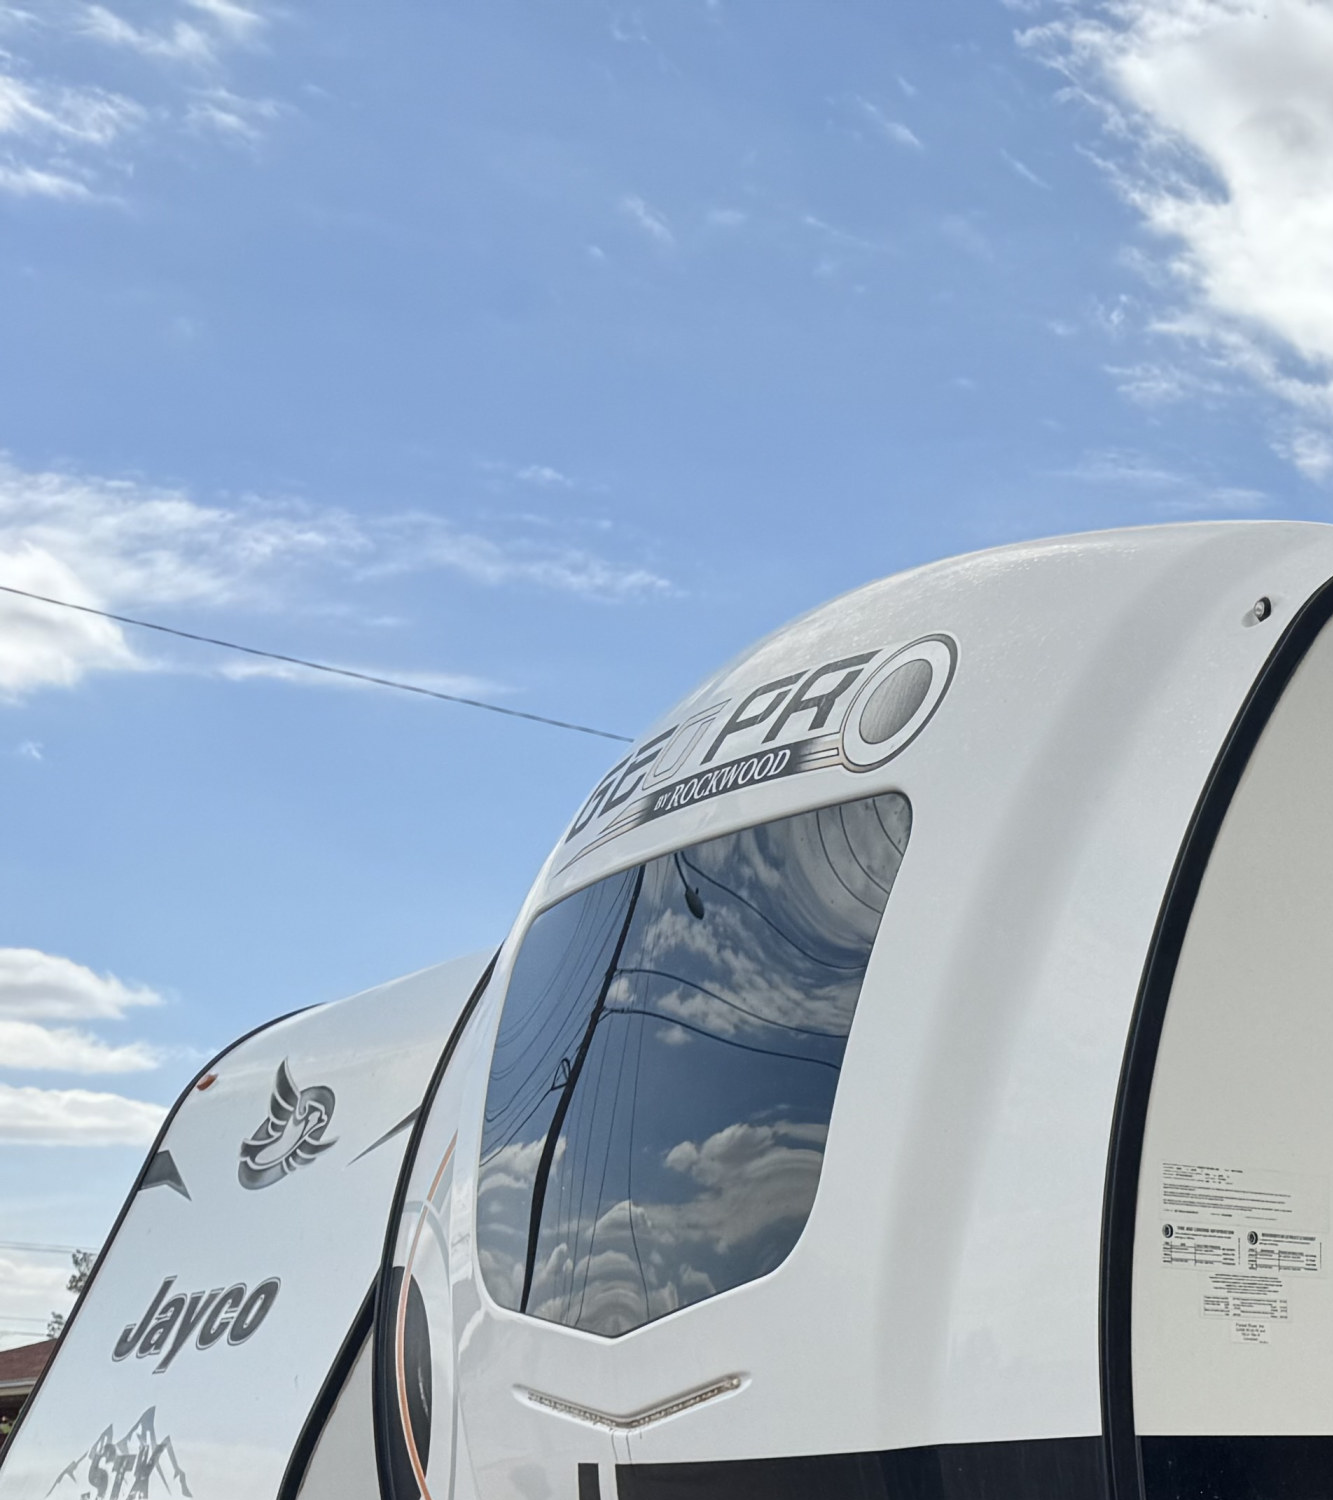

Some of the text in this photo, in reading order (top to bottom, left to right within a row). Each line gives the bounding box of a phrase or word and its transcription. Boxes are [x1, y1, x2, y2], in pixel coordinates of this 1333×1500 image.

[565, 632, 959, 844] GEO PRO
[653, 747, 792, 812] BY ROCKWOOD
[111, 1275, 282, 1376] Jayco
